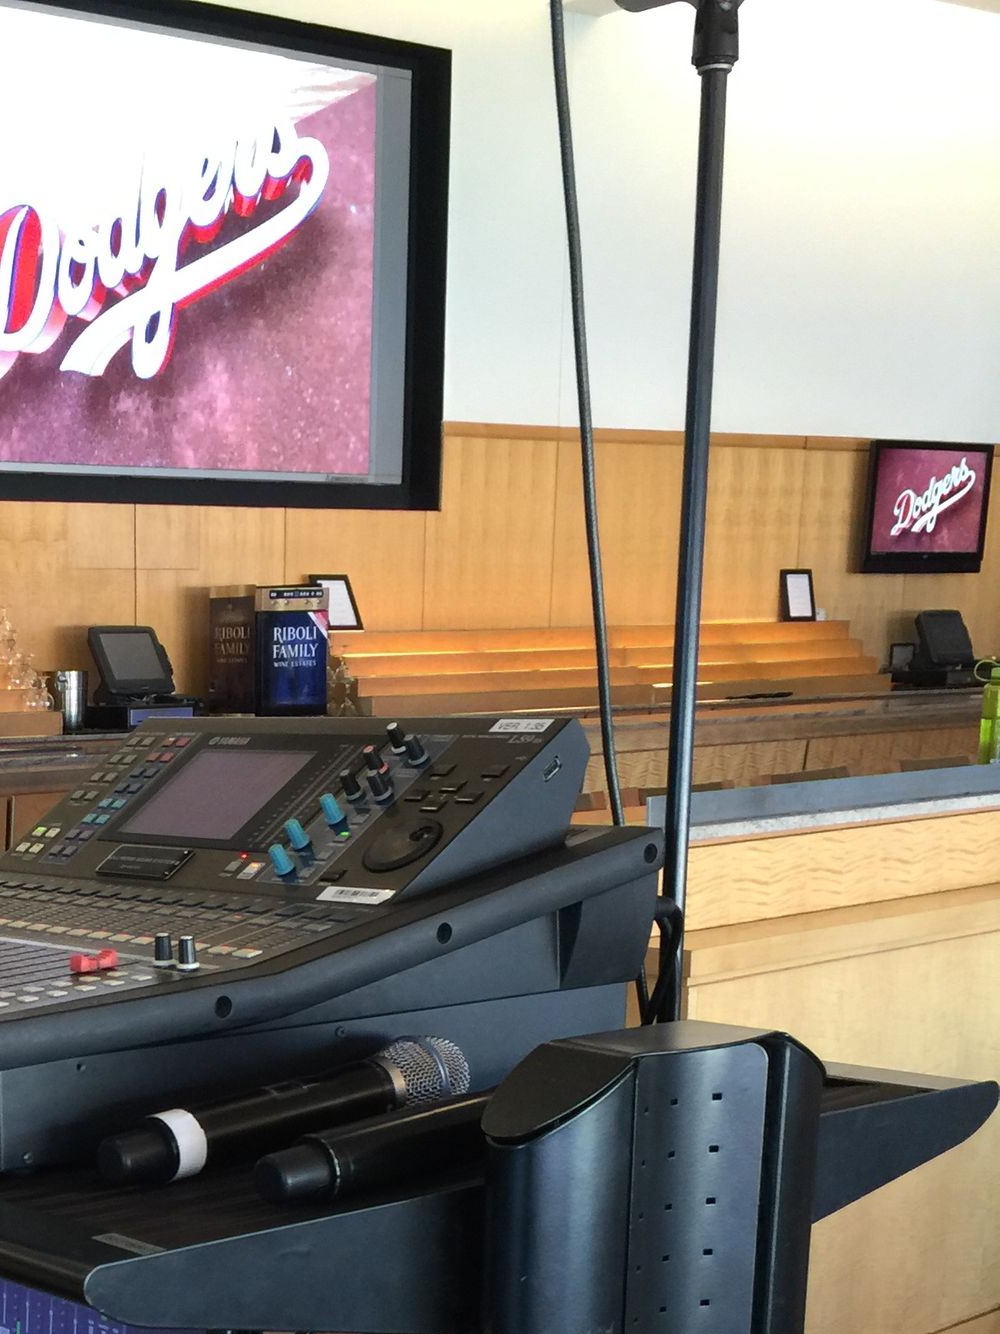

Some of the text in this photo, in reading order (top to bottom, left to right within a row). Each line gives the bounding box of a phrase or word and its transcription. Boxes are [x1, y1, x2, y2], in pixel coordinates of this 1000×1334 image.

[890, 456, 976, 536] Dodgers
[214, 625, 250, 641] RIBOLI
[273, 626, 317, 643] RIBOLI
[272, 643, 319, 659] FAMILY
